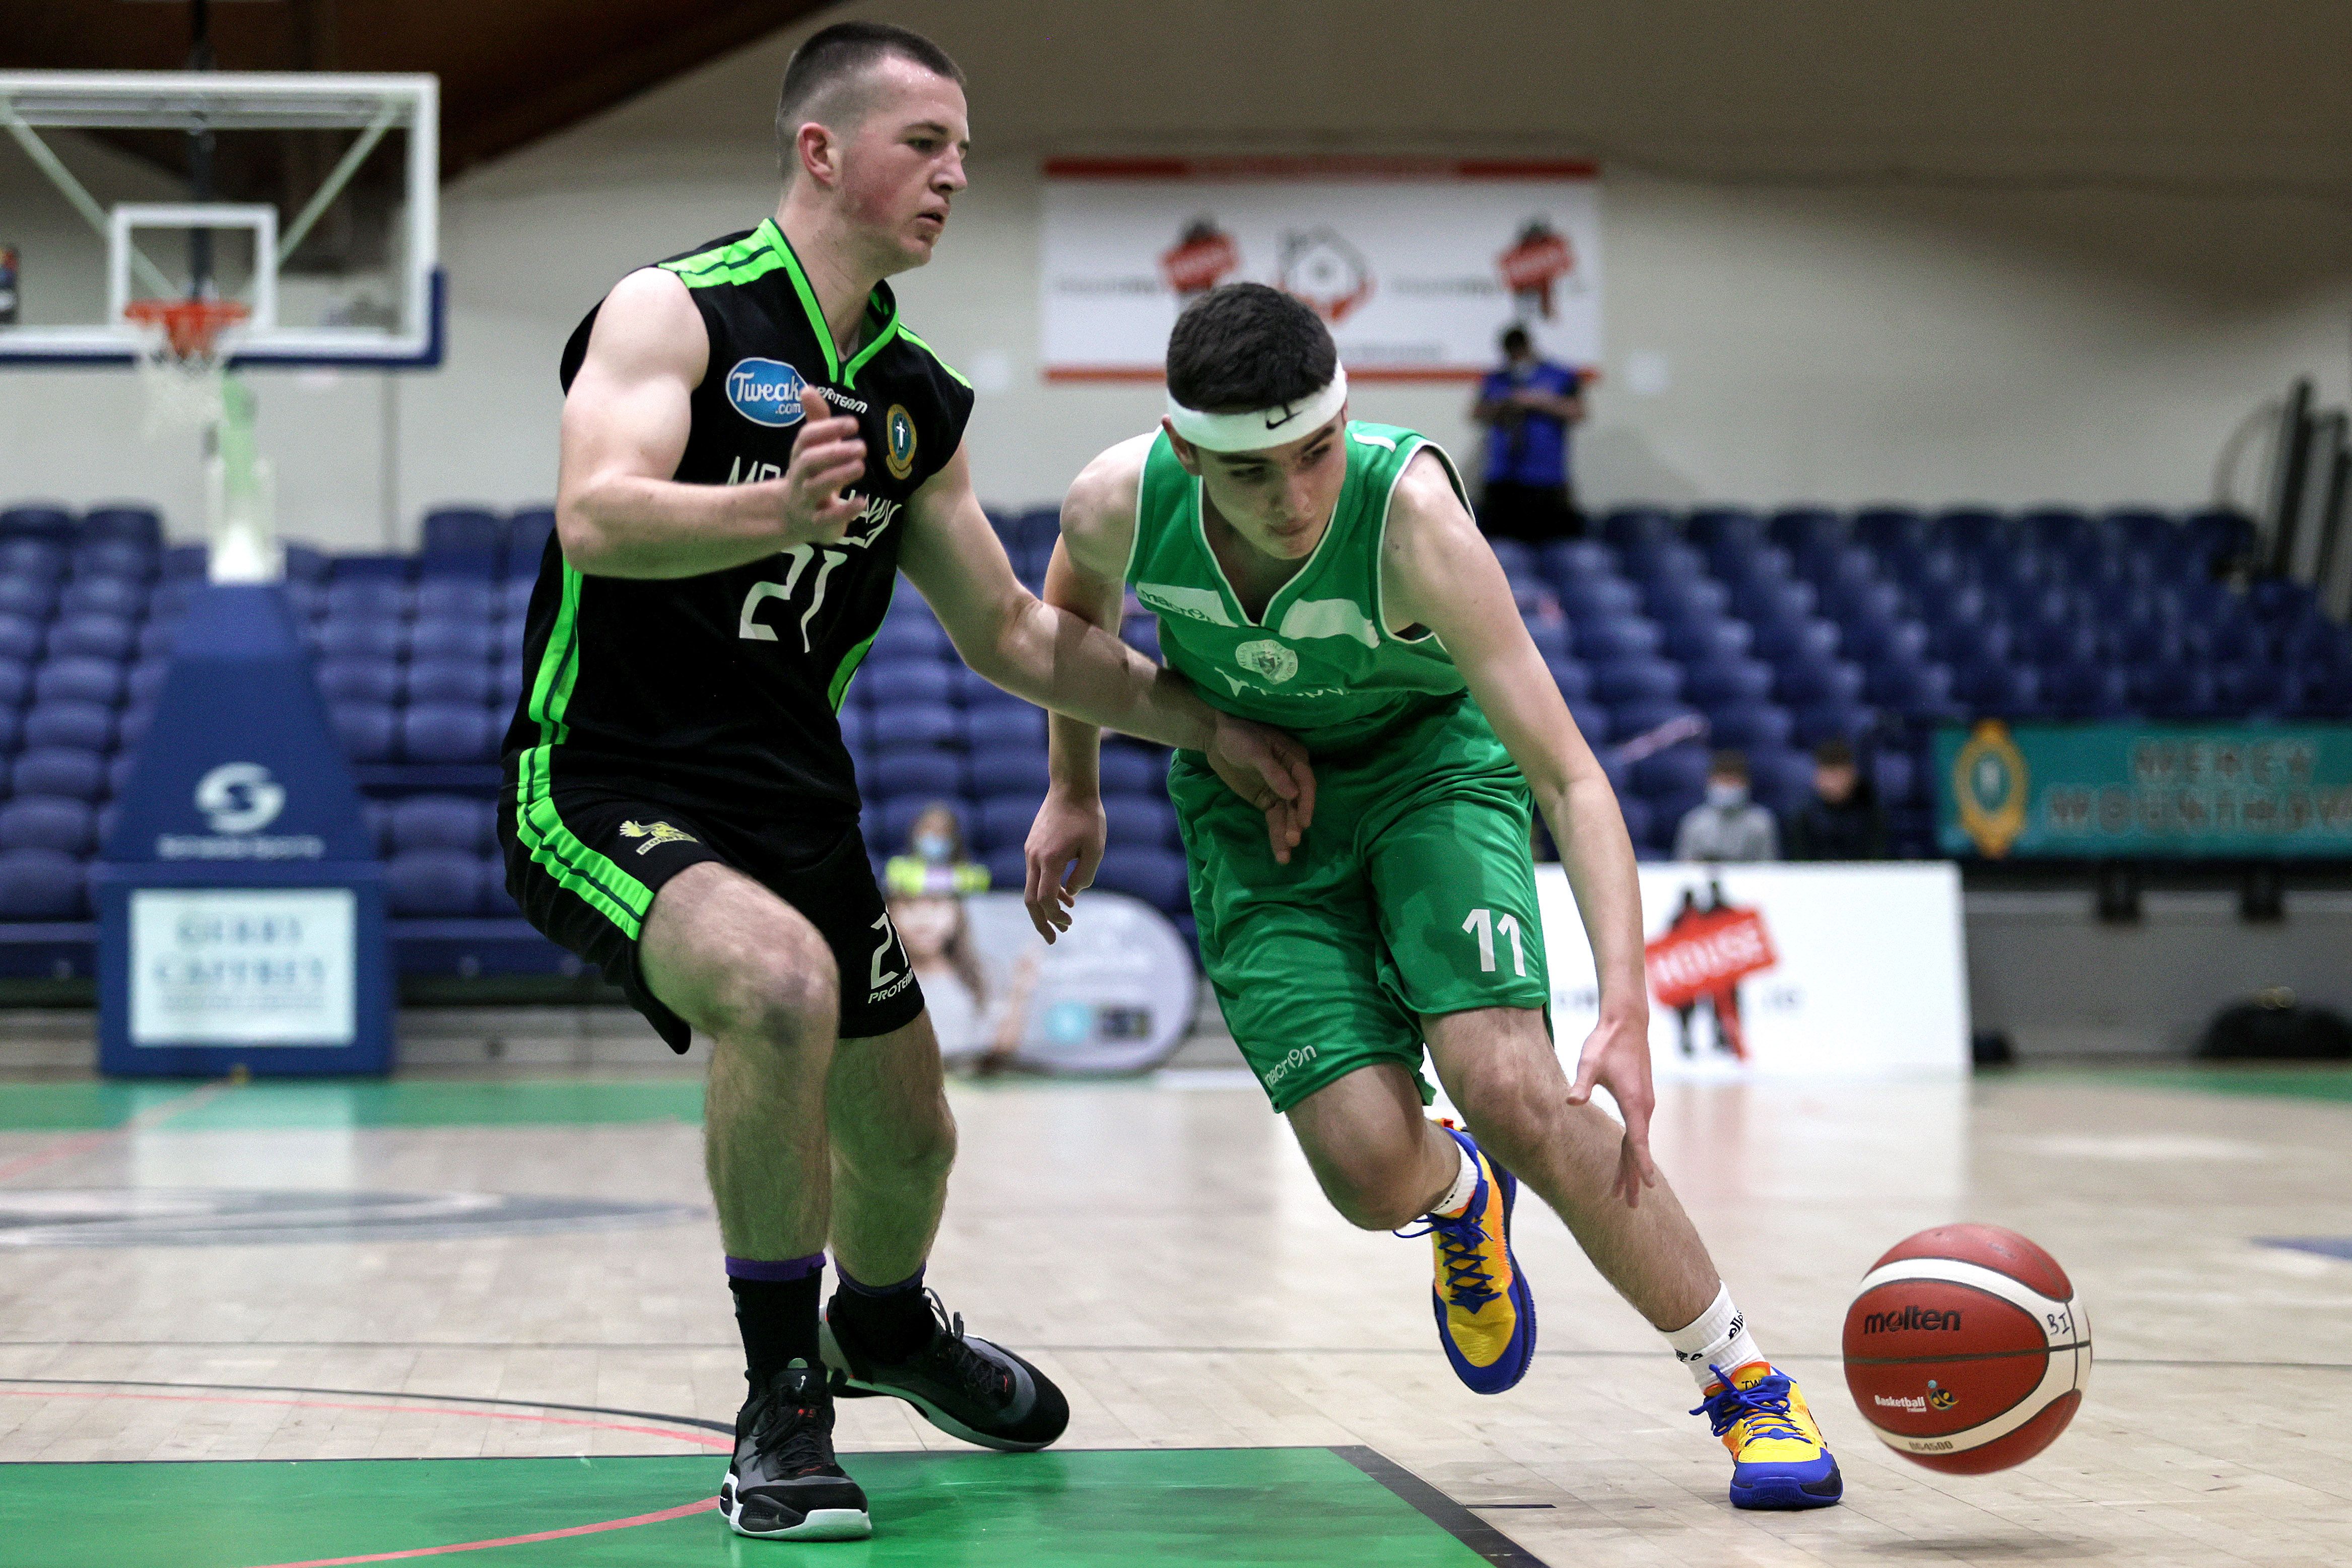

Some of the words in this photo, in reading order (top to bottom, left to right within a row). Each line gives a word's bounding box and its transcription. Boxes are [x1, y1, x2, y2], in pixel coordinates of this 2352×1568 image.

[732, 372, 802, 402] Tweak
[775, 403, 801, 414] .com
[1462, 909, 1526, 977] 11
[1864, 1305, 1961, 1334] molten
[1874, 1394, 1926, 1407] Basketball
